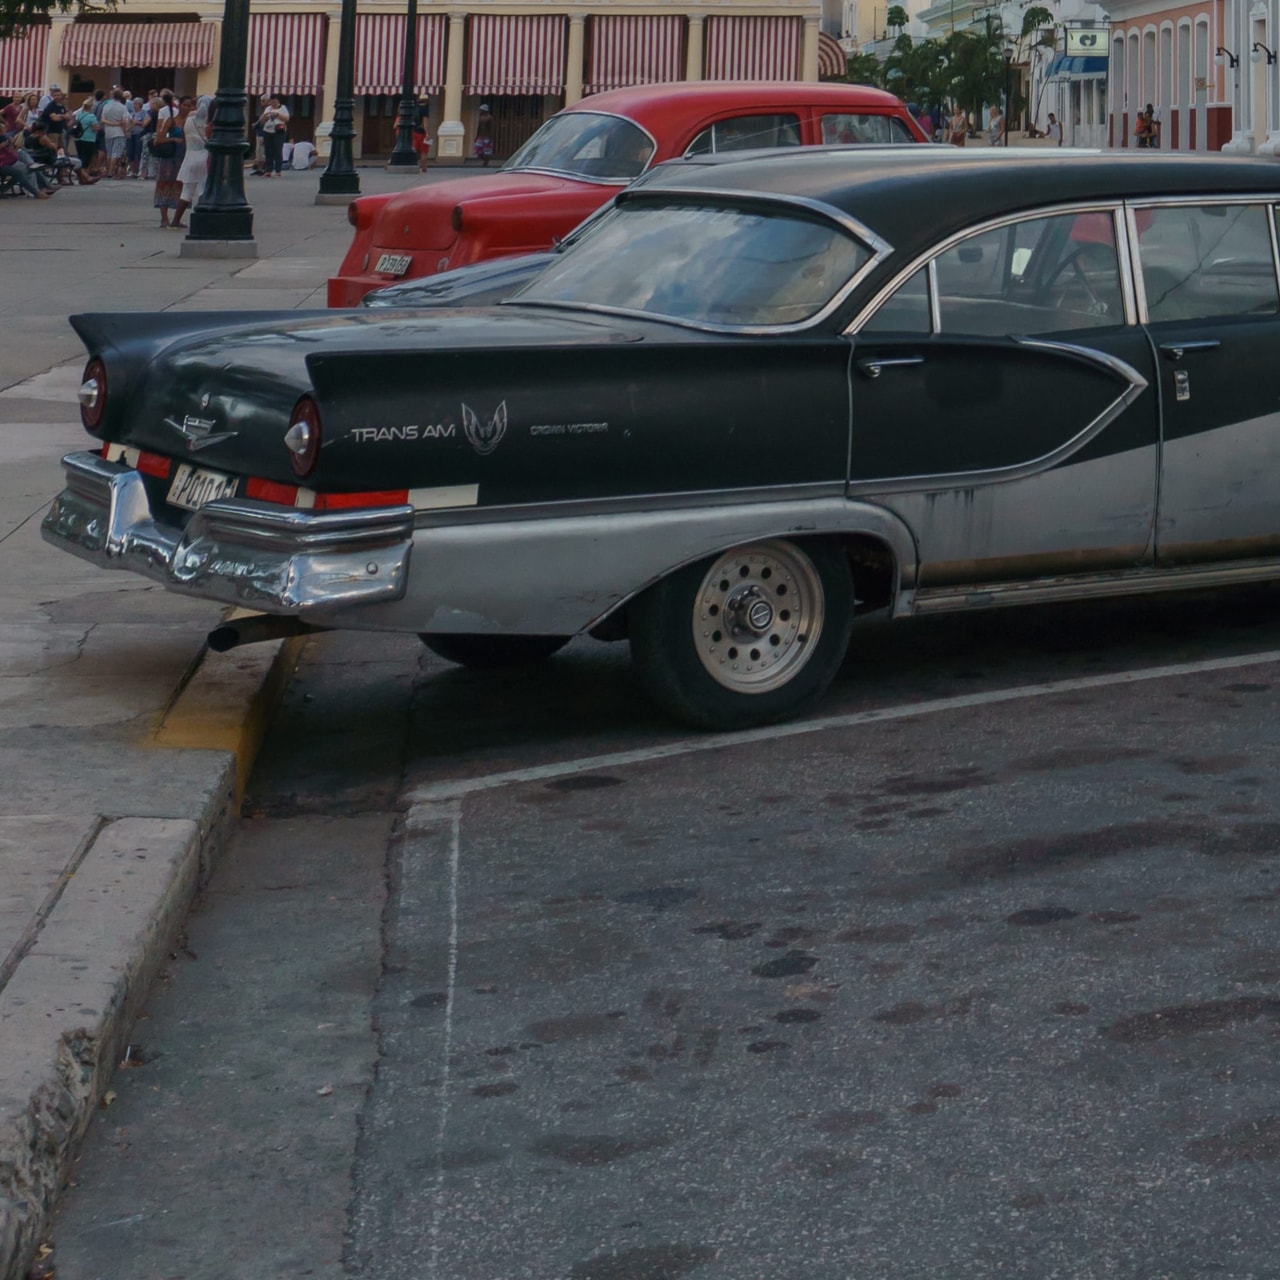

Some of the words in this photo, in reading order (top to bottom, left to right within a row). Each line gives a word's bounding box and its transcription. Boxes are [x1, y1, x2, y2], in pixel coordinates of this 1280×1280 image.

[351, 426, 419, 442] TRANS
[422, 424, 456, 439] AM
[530, 425, 565, 436] CROWN
[567, 422, 609, 434] VICTORIA
